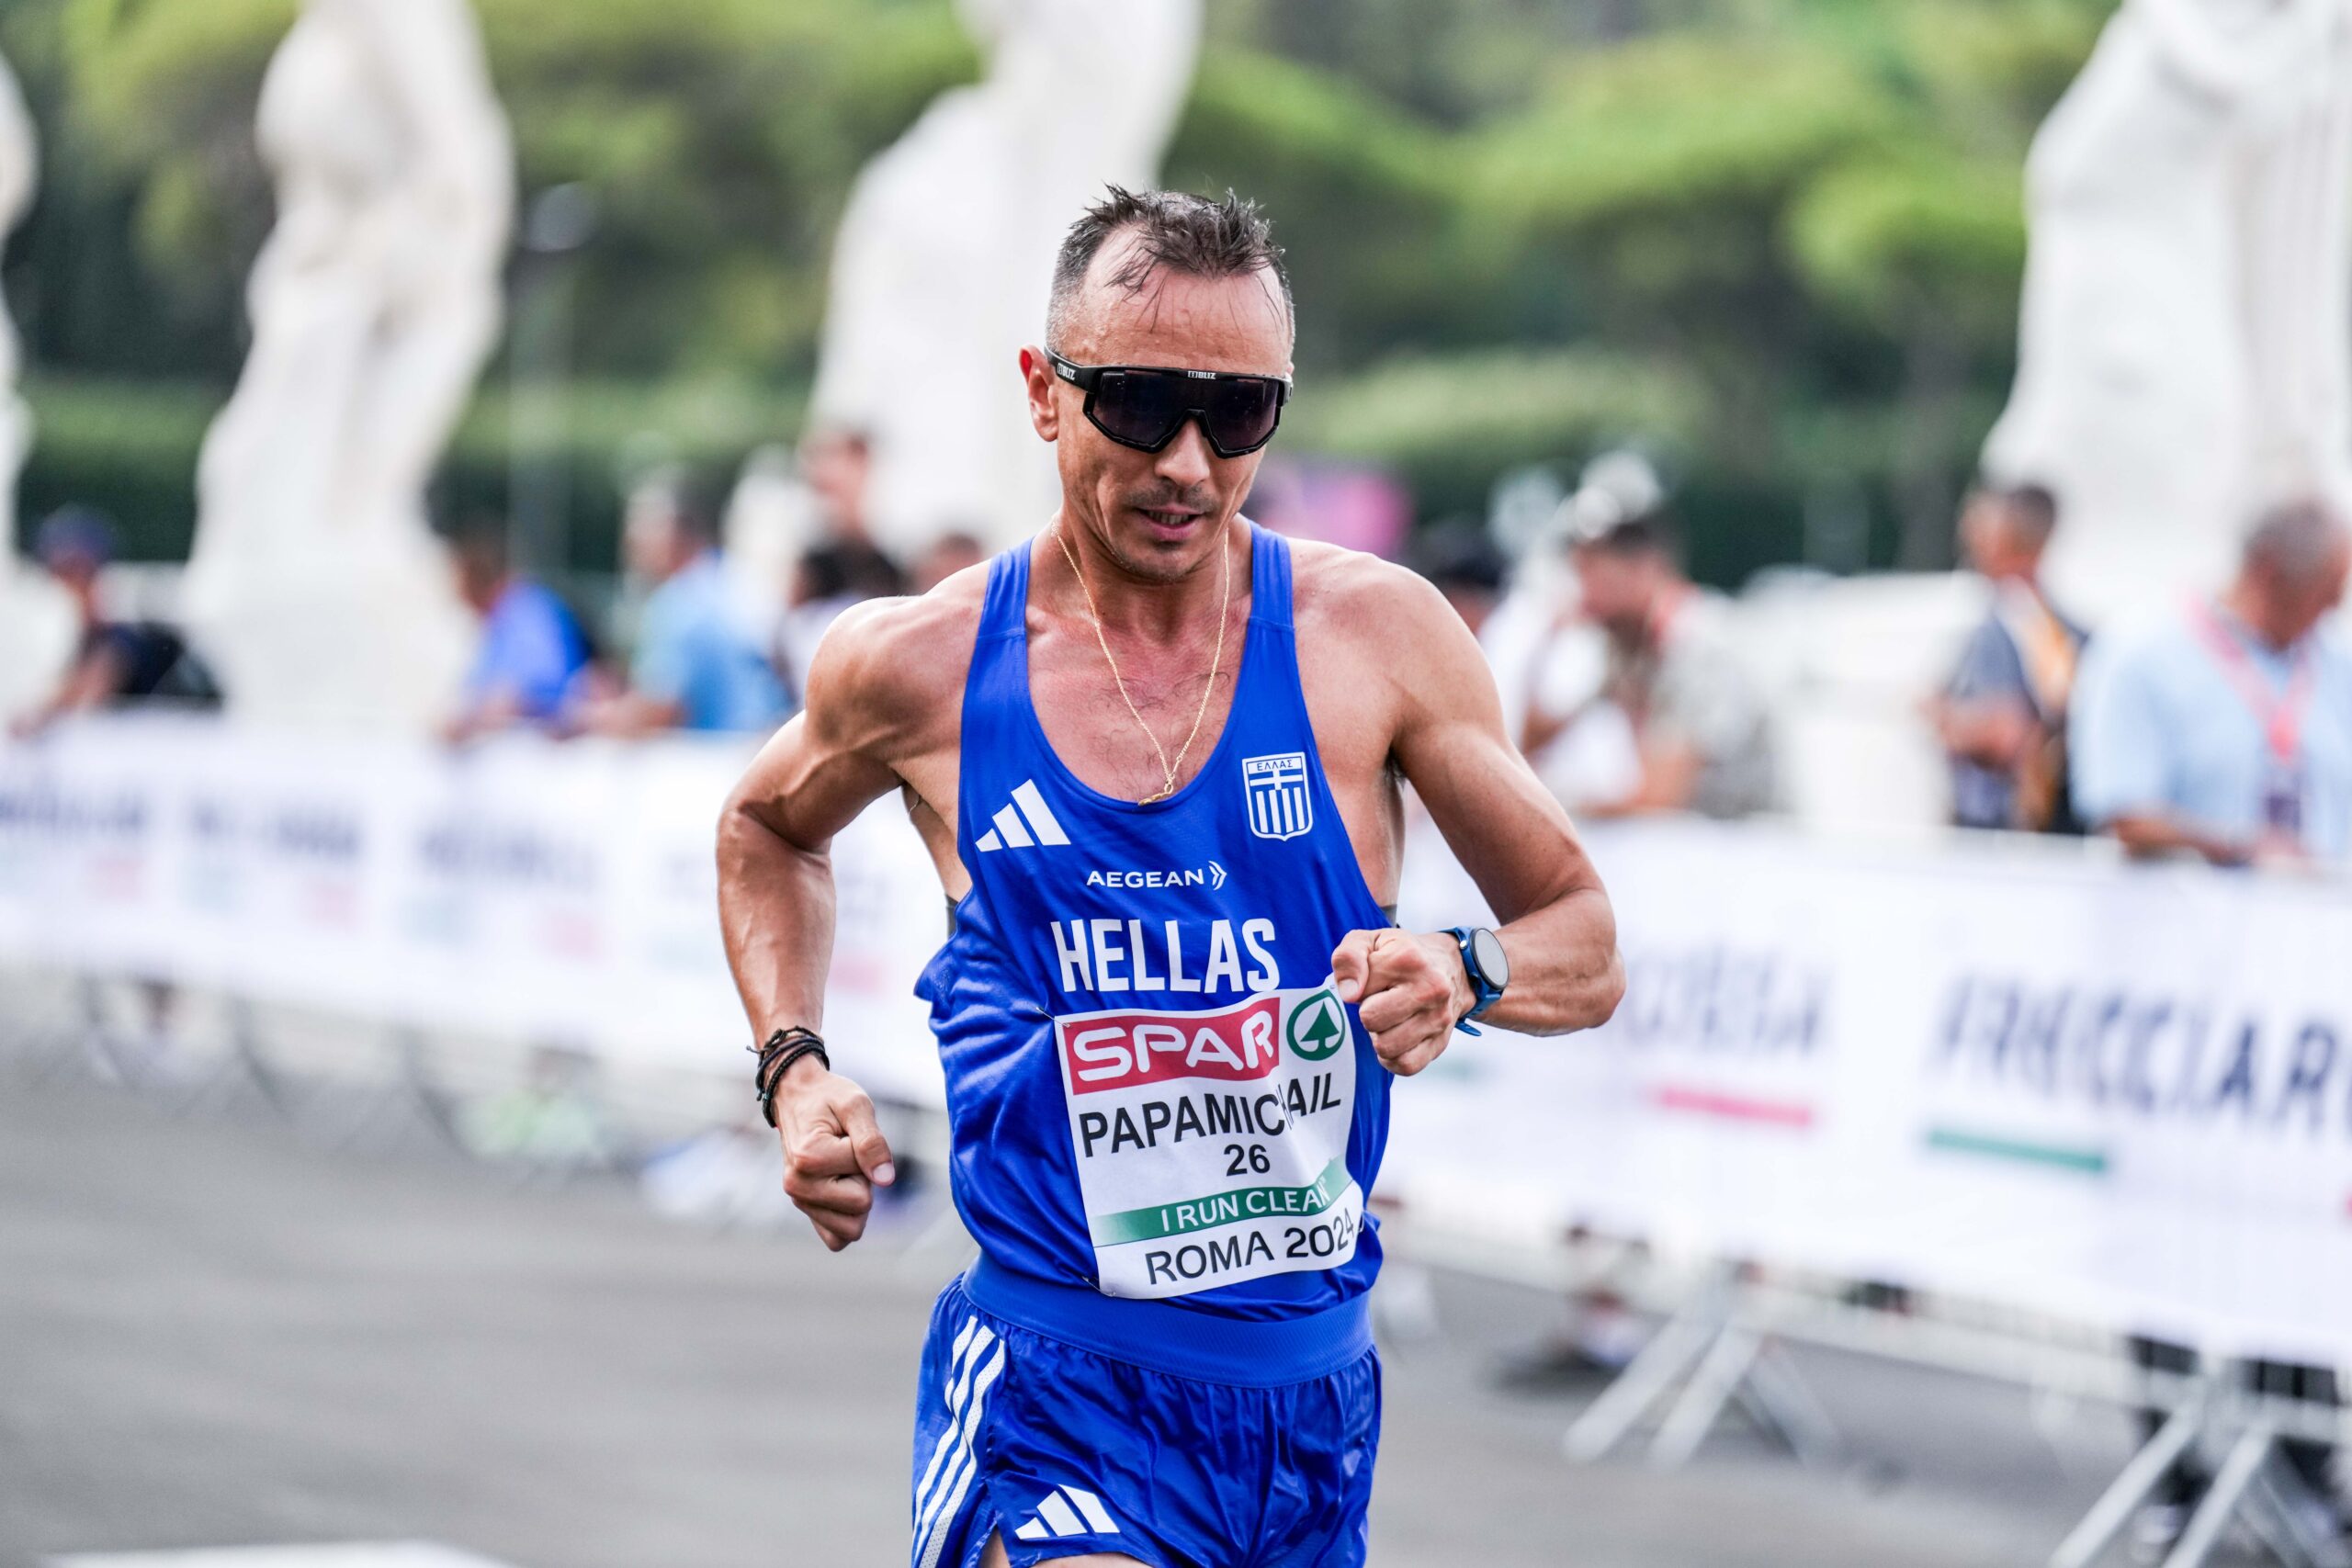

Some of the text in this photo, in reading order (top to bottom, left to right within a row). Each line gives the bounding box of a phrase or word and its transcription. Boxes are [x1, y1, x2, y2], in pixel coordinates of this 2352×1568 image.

[1086, 868, 1204, 889] AEGEAN
[1050, 918, 1281, 994] HELLAS
[1072, 1010, 1274, 1082] SPAR
[1223, 1144, 1271, 1177] 26
[1160, 1209, 1170, 1232] I
[1176, 1194, 1239, 1230] RUN
[1145, 1207, 1354, 1286] ROMA 2024
